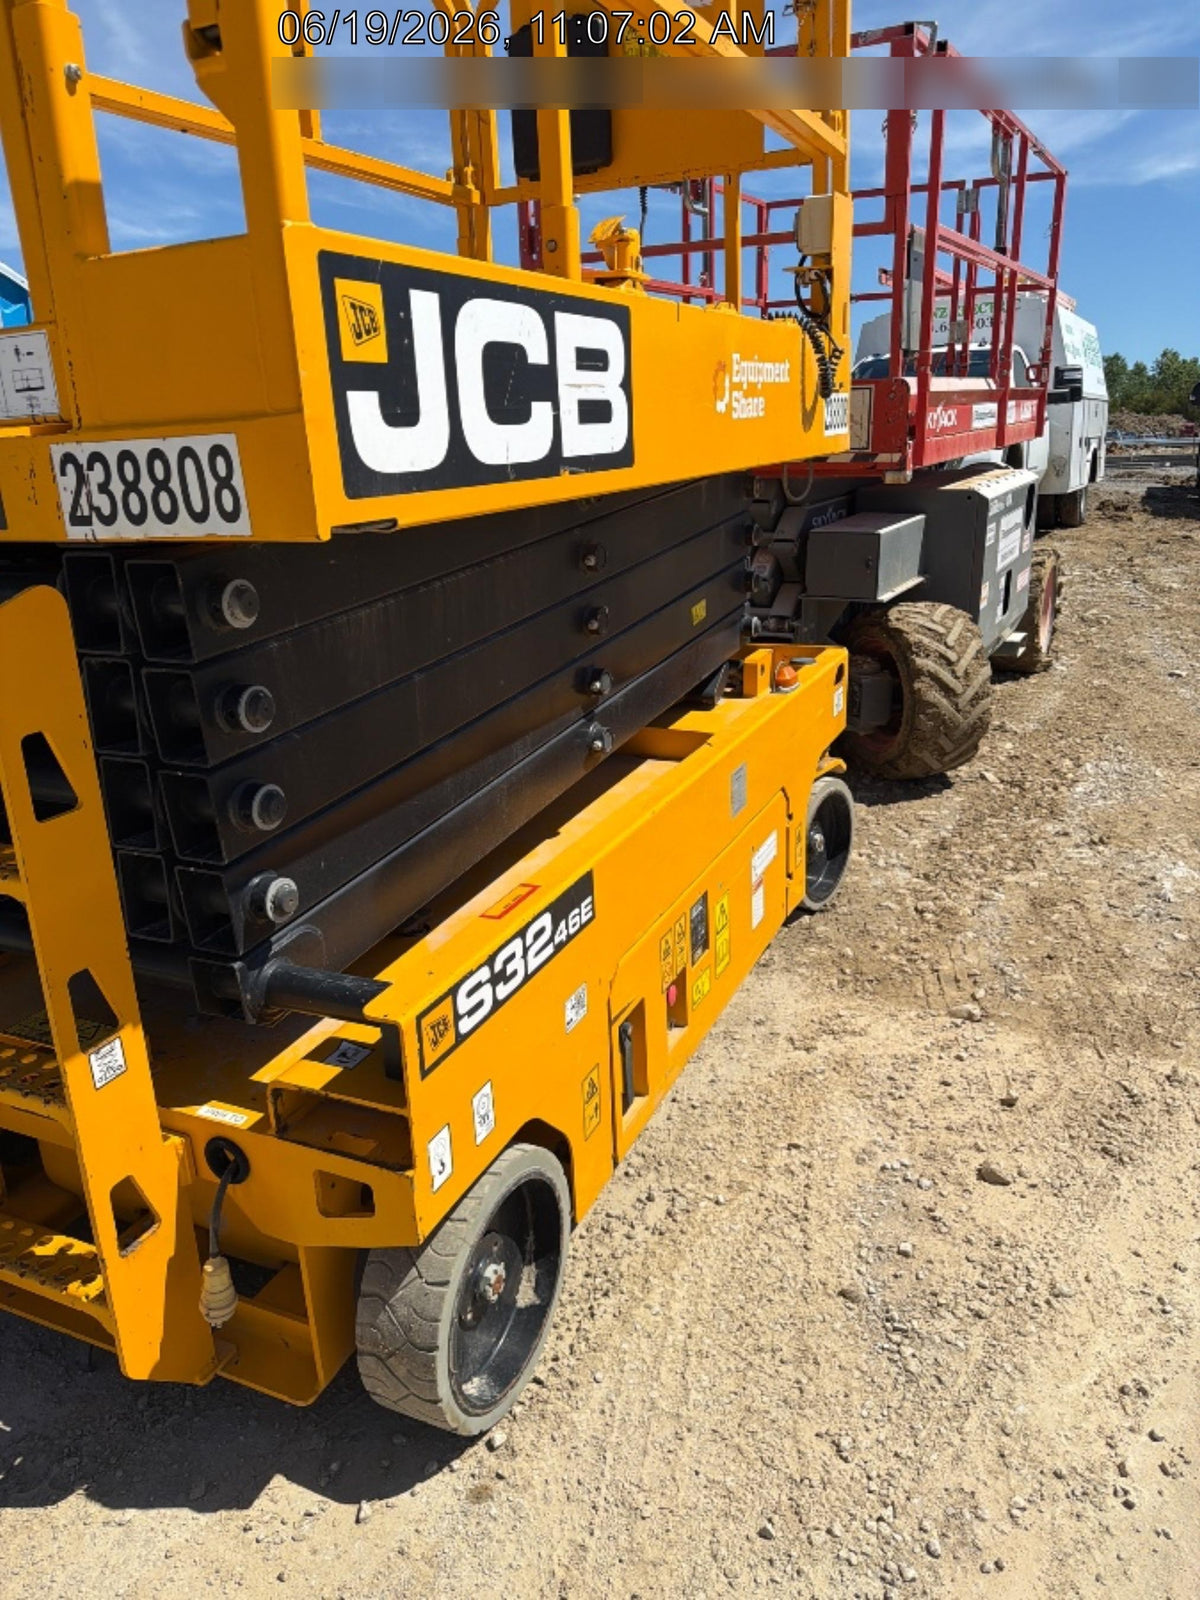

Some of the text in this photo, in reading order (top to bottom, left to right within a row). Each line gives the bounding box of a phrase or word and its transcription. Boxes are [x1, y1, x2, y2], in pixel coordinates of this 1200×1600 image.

[347, 301, 379, 340] JCB
[346, 288, 629, 474] JCB
[732, 353, 790, 390] Equipment
[732, 390, 765, 420] Share
[927, 400, 958, 433] KYJACK
[60, 444, 241, 527] 238808
